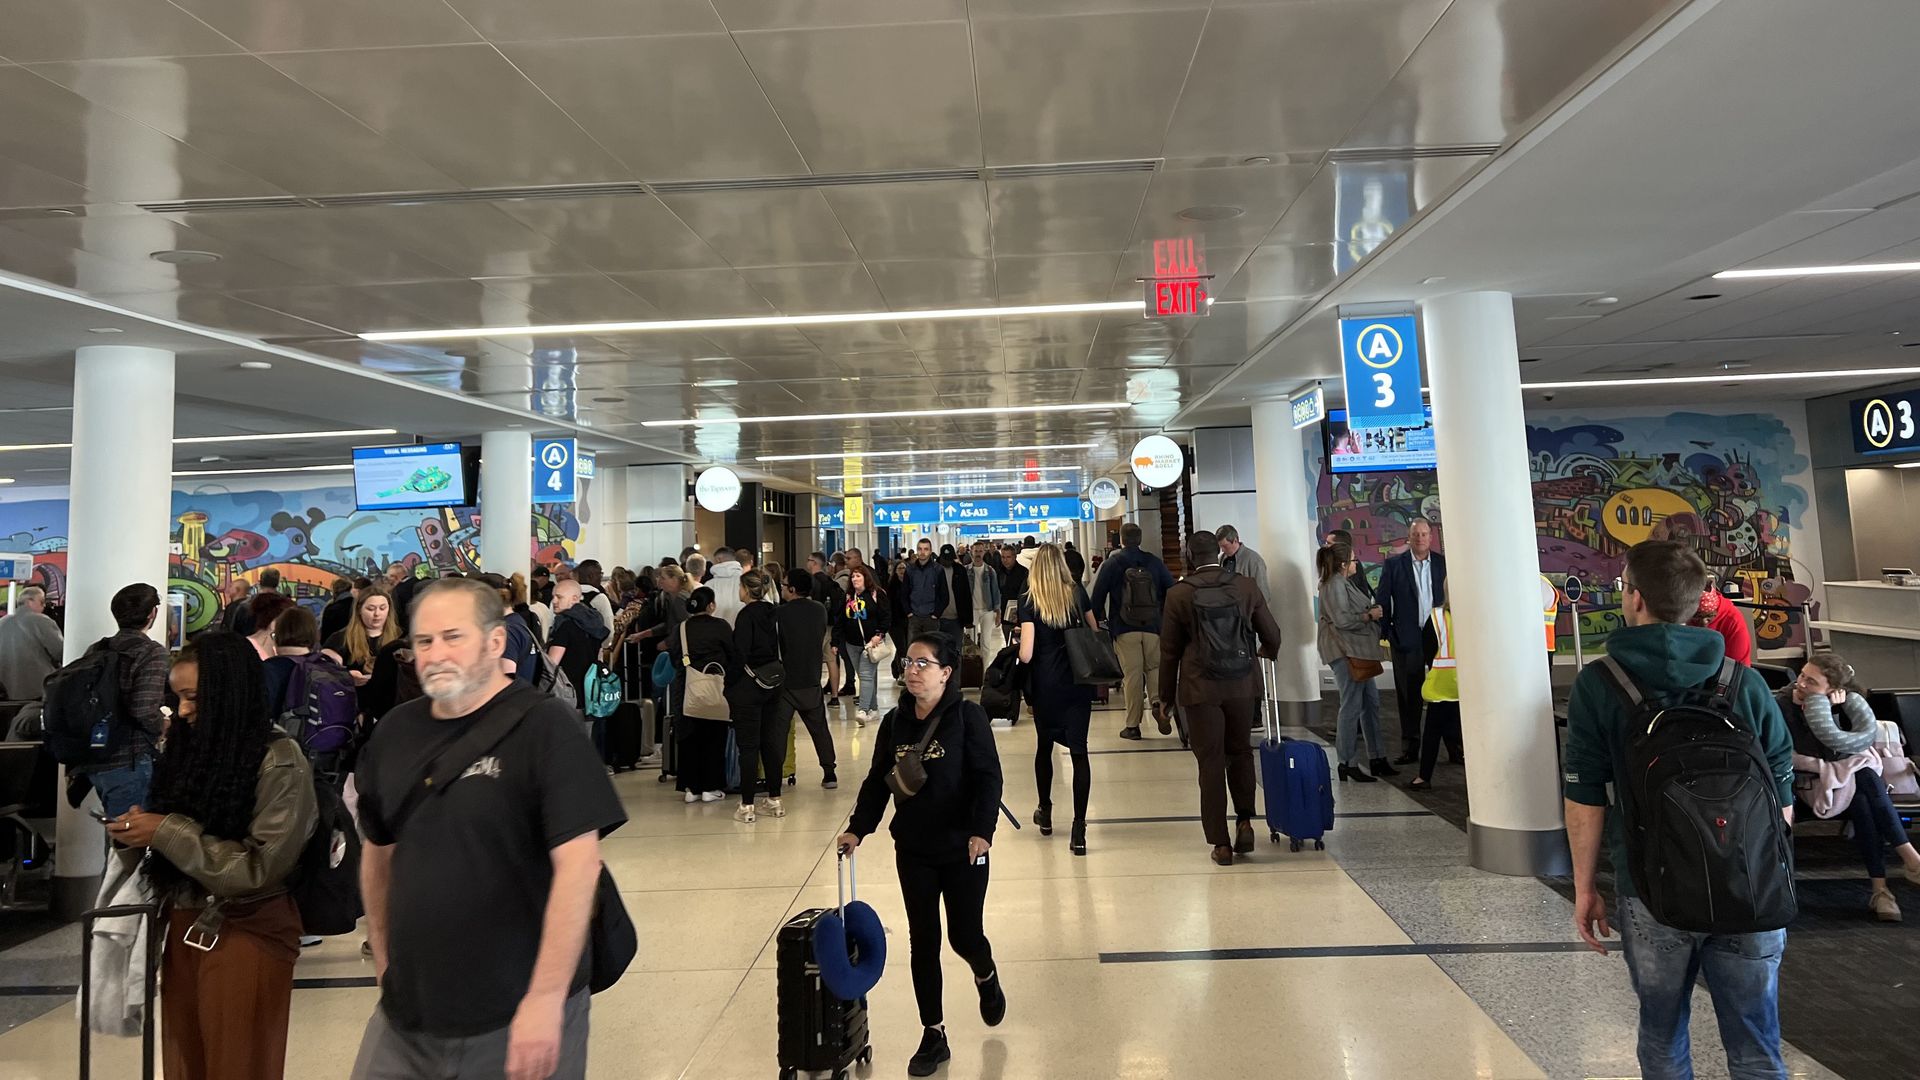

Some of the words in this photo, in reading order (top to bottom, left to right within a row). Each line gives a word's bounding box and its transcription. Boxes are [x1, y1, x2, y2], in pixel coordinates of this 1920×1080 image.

[1156, 281, 1200, 315] EXIT
[1369, 332, 1393, 358] A
[1372, 372, 1395, 408] 3
[1871, 408, 1888, 437] A
[1896, 400, 1915, 439] 3
[548, 447, 562, 463] A
[547, 470, 562, 491] 4
[960, 509, 988, 517] A5-A13
